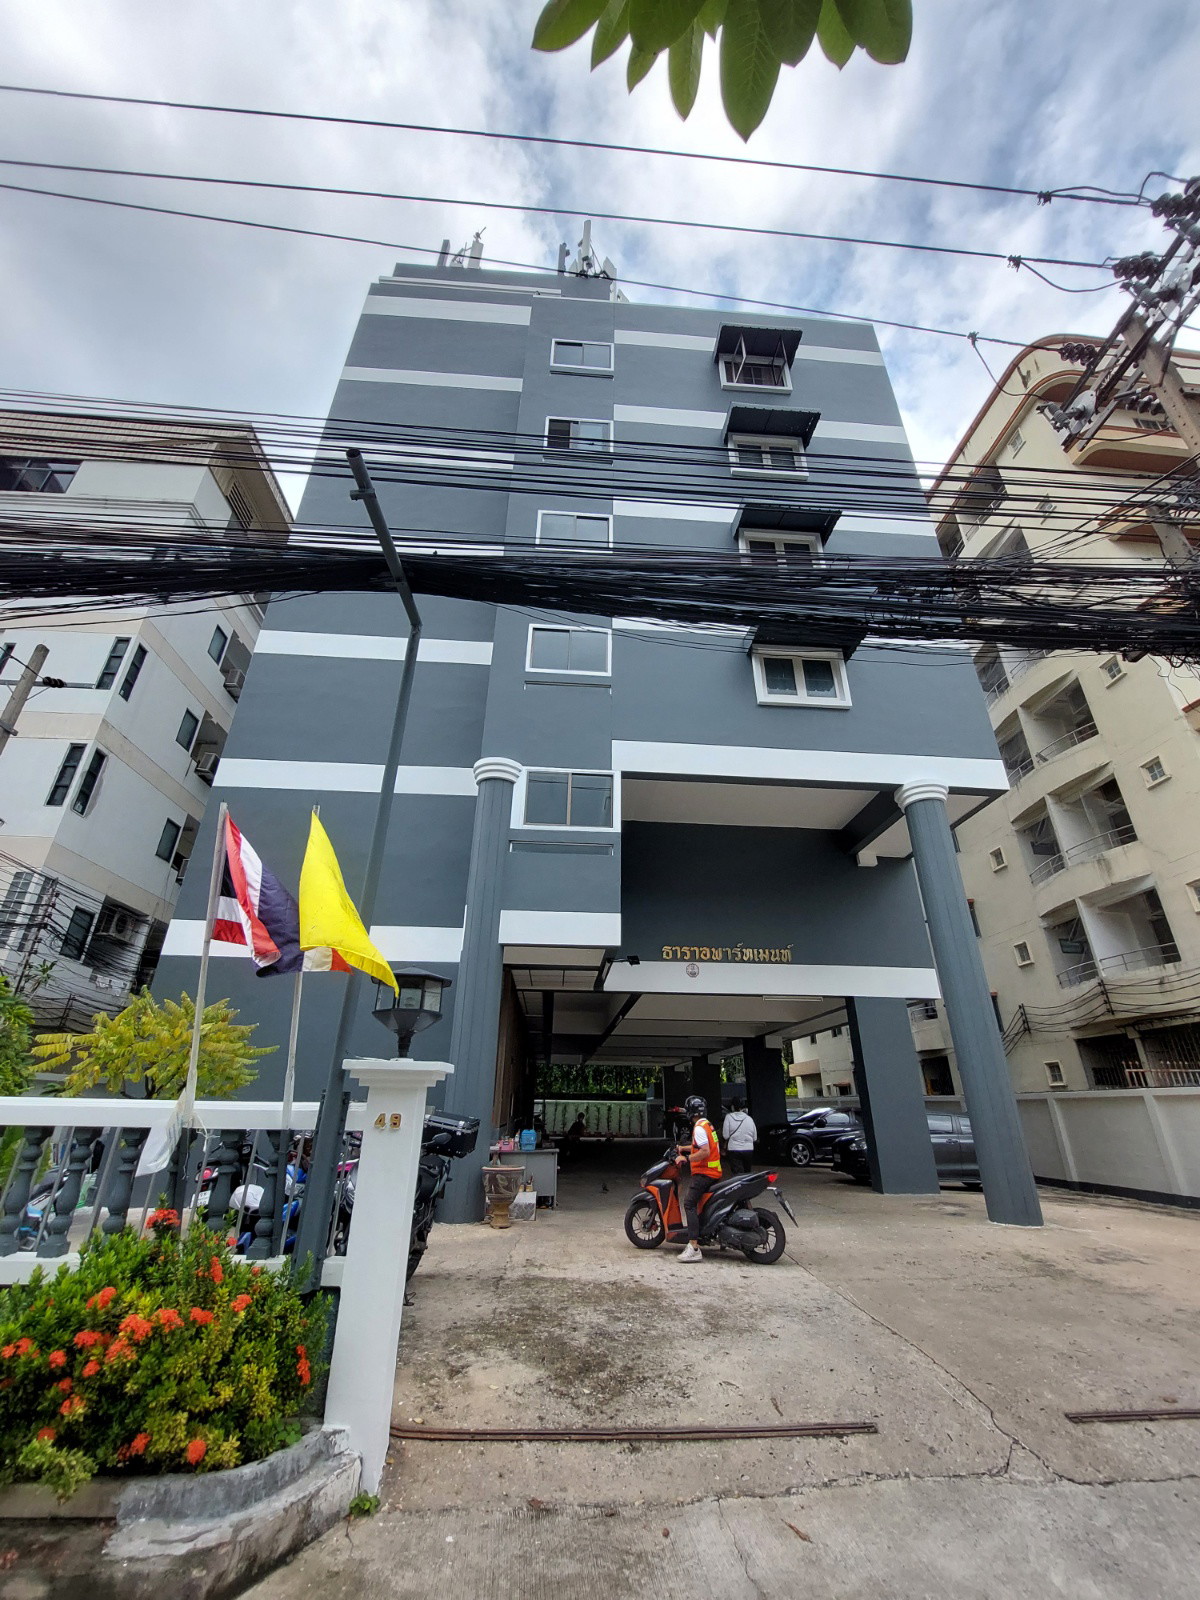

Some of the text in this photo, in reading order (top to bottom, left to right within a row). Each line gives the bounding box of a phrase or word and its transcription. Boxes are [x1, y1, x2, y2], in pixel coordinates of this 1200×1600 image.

[661, 942, 794, 962] ธาราอพาร์ทเมนท์
[374, 1112, 402, 1130] 49
